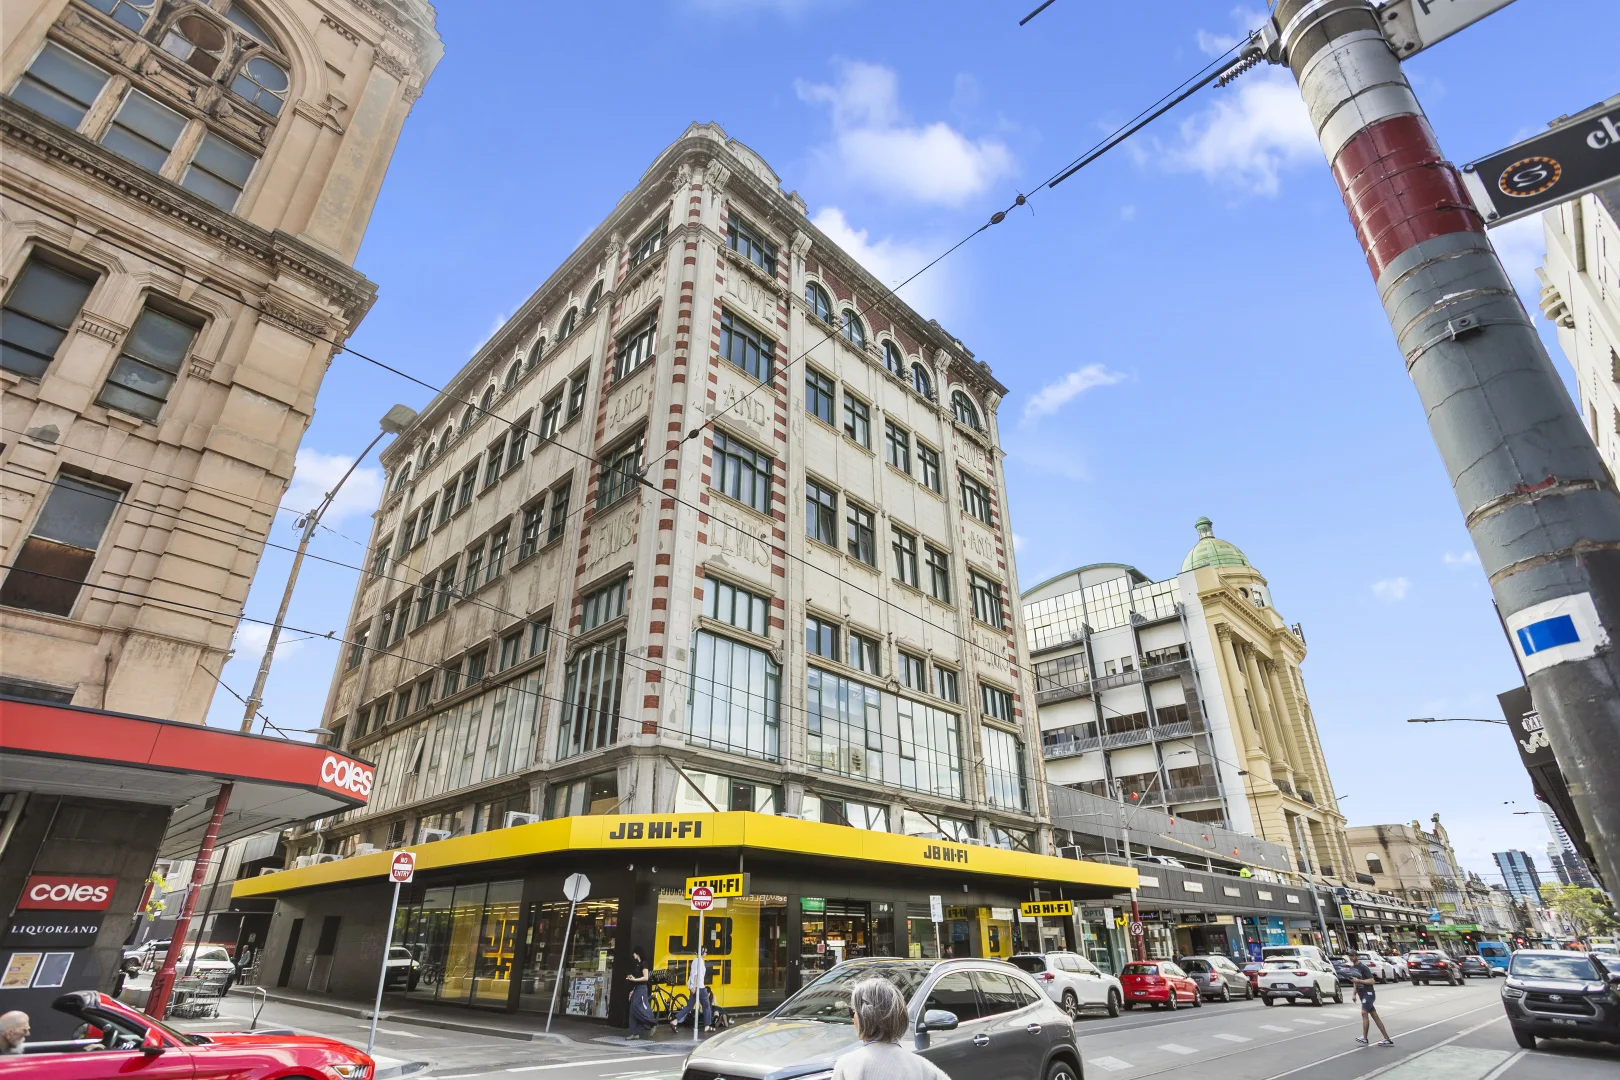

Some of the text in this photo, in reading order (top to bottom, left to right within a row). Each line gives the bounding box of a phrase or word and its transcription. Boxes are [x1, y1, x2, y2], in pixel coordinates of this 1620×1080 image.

[321, 756, 373, 796] coles
[609, 822, 644, 840] JB
[923, 845, 940, 860] JB
[393, 870, 411, 878] ENTRY
[30, 883, 109, 902] coles
[1024, 905, 1041, 914] JB
[11, 925, 98, 935] LIQUORLAND
[668, 916, 733, 955] JB
